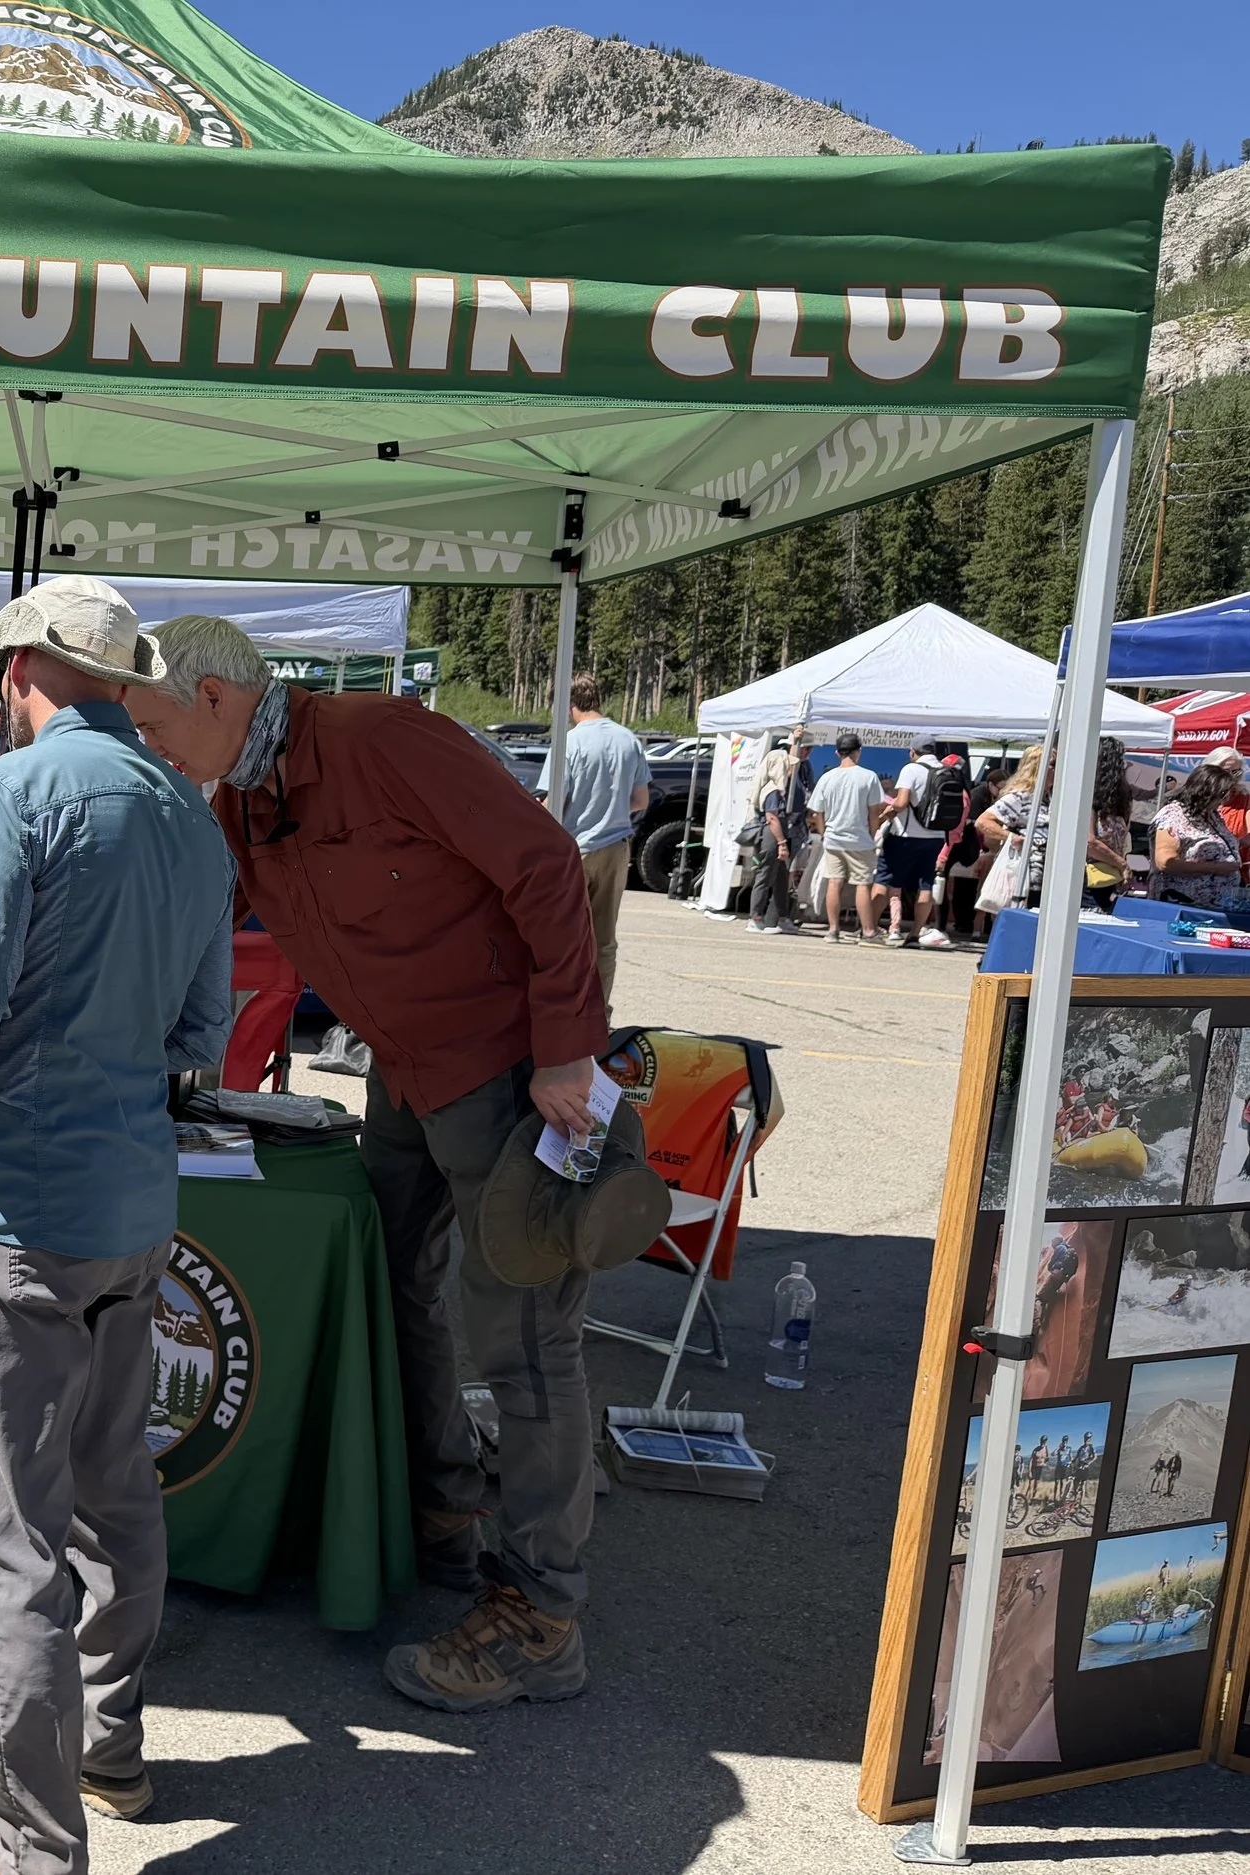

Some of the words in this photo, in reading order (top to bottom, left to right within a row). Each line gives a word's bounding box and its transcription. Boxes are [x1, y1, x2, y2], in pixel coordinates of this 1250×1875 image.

[199, 116, 234, 148] CLU
[649, 285, 1065, 382] CLUB
[642, 1055, 655, 1086] CLUB
[212, 1335, 249, 1431] CLUB
